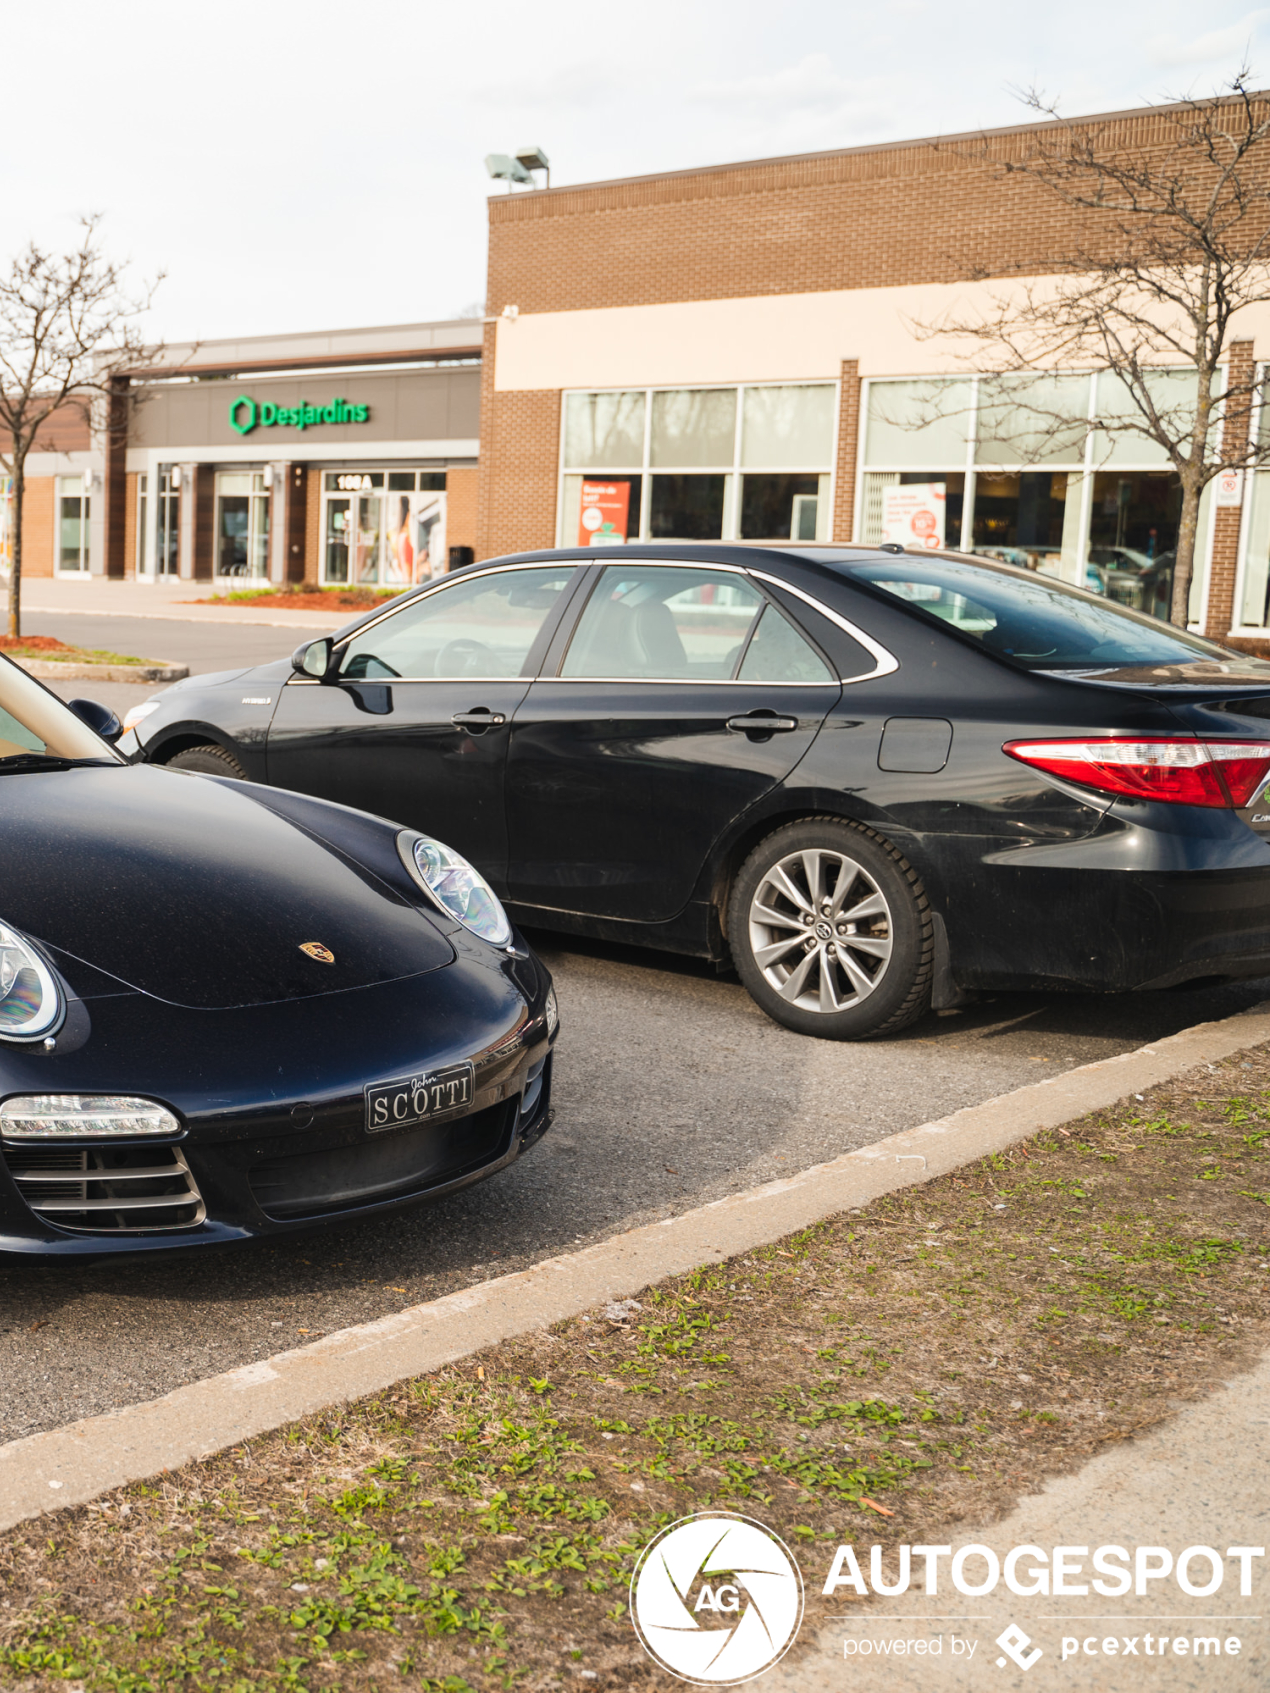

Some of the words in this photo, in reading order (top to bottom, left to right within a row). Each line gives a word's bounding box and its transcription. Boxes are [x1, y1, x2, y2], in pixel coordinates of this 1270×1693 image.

[260, 397, 368, 430] Desjardins
[373, 1077, 469, 1125] SCOTTI
[411, 1074, 437, 1098] John
